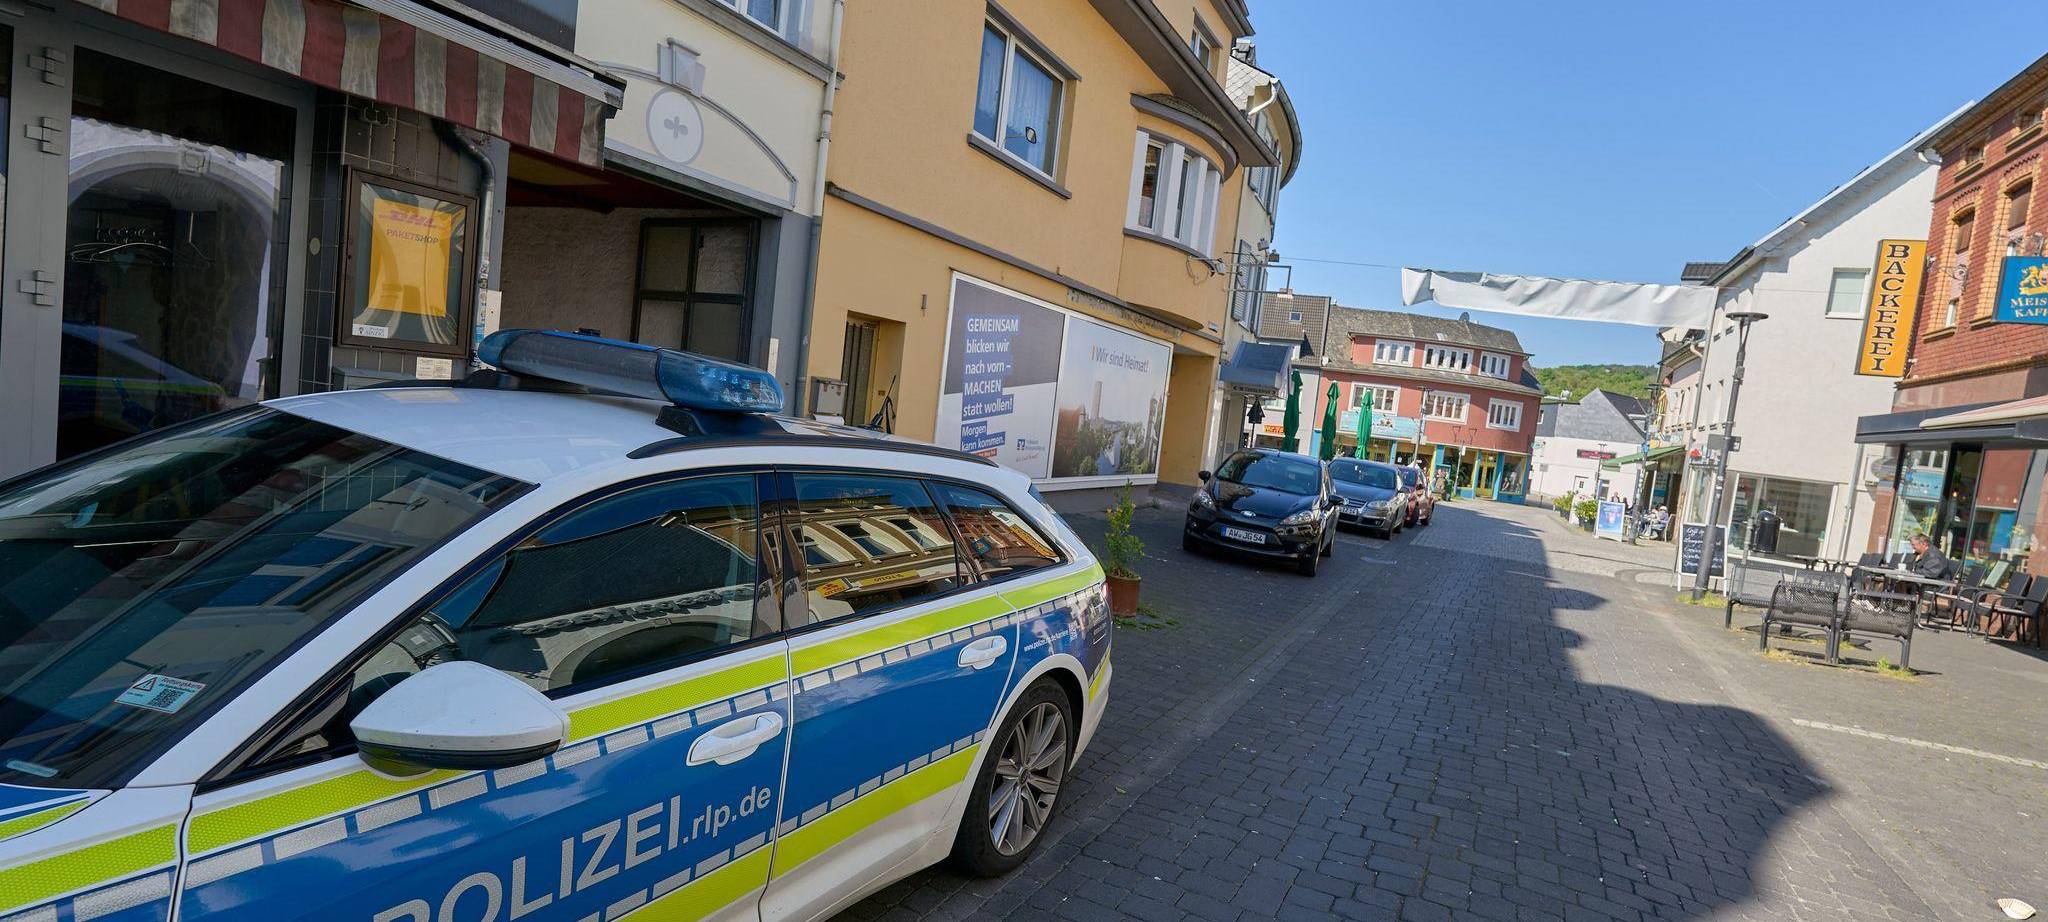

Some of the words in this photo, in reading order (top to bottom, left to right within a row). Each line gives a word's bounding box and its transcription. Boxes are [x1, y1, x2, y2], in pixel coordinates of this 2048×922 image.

[391, 210, 436, 228] DHL
[386, 229, 440, 244] PAKETSHOP
[1870, 244, 1910, 371] BÄCKEREI
[967, 318, 1019, 332] GEMEINSAM
[966, 339, 995, 353] blicken
[996, 338, 1010, 353] wir
[965, 360, 985, 375] nach
[987, 361, 1005, 374] vorn
[1096, 346, 1109, 363] Wir
[1109, 350, 1124, 367] sind
[1125, 353, 1151, 373] Heimat!
[964, 380, 1002, 396] MACHEN
[963, 403, 983, 417] statt
[984, 397, 1013, 414] wollen!
[961, 424, 987, 438] Morgen
[961, 440, 977, 453] kann
[978, 436, 1004, 451] kommen.
